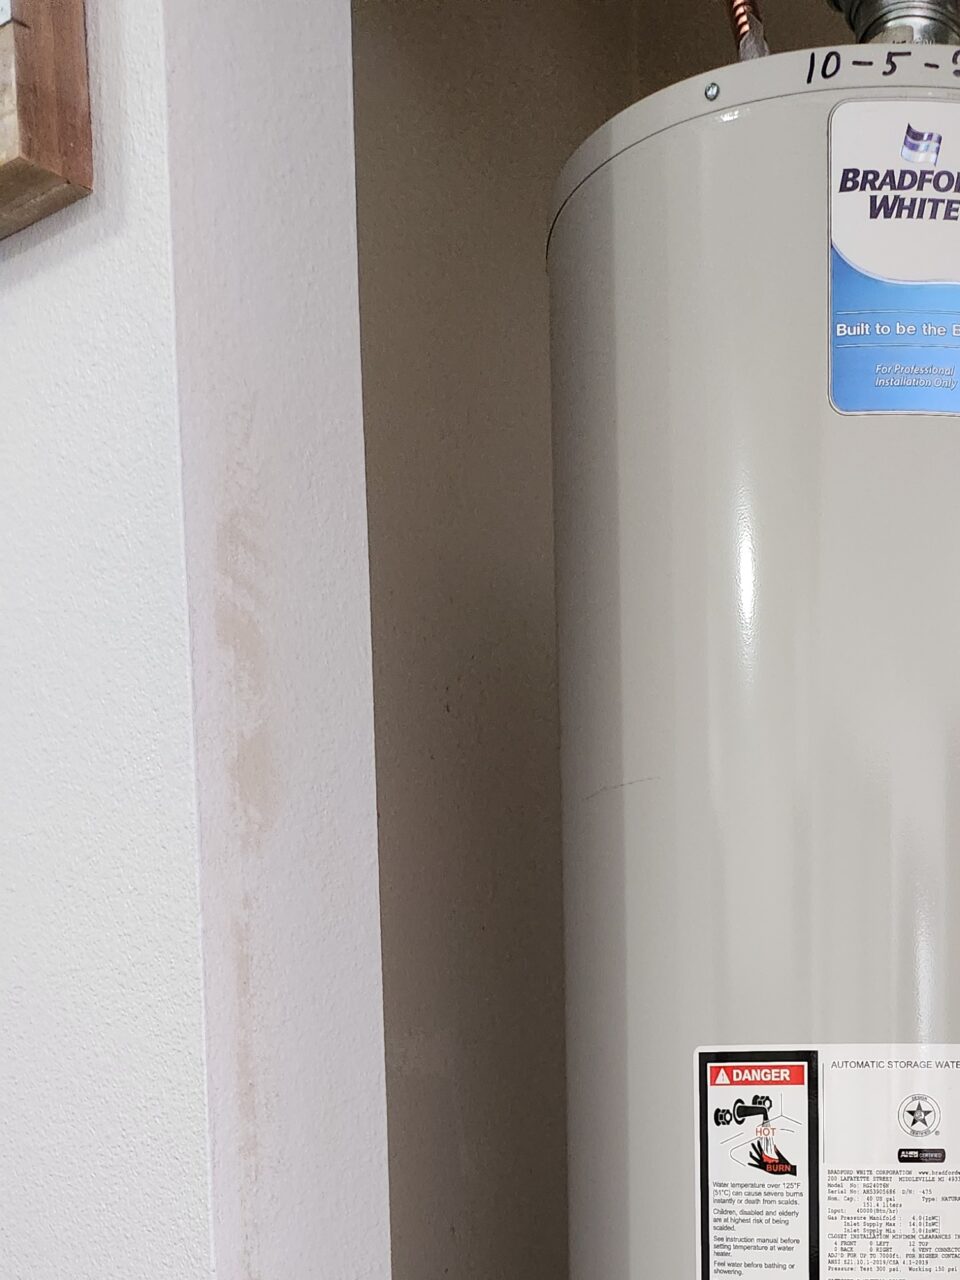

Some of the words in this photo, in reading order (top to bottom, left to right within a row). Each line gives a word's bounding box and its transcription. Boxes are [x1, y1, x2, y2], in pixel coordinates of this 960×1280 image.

[869, 195, 959, 221] WHITE
[837, 323, 871, 336] Built
[875, 324, 891, 336] to
[896, 323, 916, 336] be
[922, 323, 947, 336] the
[875, 364, 892, 375] For
[894, 364, 955, 376] Professional
[874, 377, 932, 388] Installation
[934, 378, 958, 390] Only
[830, 1060, 884, 1068] AUTOMATIC
[733, 1069, 790, 1081] DANGER
[756, 1128, 776, 1136] HOT
[712, 1181, 728, 1189] Water
[713, 1208, 737, 1216] Children,
[771, 1217, 789, 1225] being
